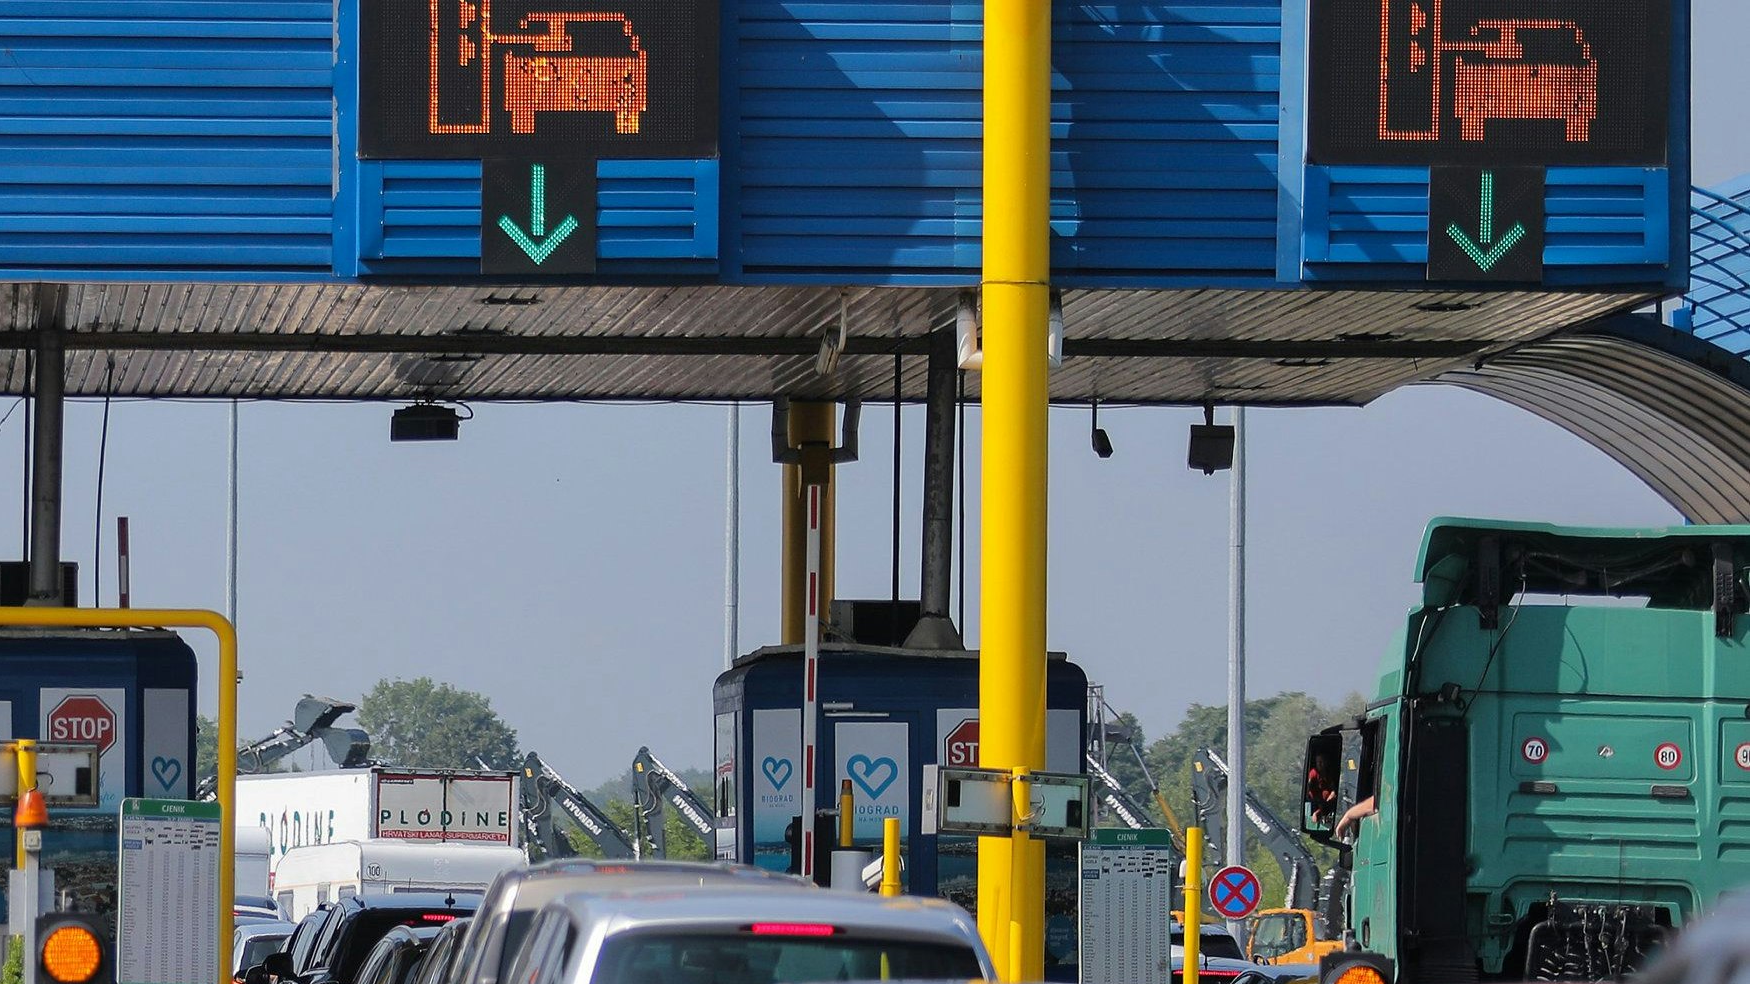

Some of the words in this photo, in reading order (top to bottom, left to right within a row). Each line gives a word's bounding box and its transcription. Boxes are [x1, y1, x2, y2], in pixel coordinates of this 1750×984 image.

[54, 717, 111, 740] STOP
[951, 741, 979, 764] ST
[1528, 744, 1543, 757] 70
[1660, 750, 1675, 763] 80
[761, 795, 793, 803] BIOGRAD
[161, 804, 186, 813] CJENIK
[672, 795, 713, 834] HYUNDAI
[854, 804, 899, 815] IOGRAD
[1105, 794, 1144, 829] HYUNDA
[380, 809, 508, 827] PLODINE
[563, 798, 602, 836] HYUNDAI
[382, 830, 419, 839] HRVATSKI
[447, 832, 507, 841] SUPERMARKETA
[1116, 833, 1138, 841] CJENIK
[368, 865, 381, 875] 100
